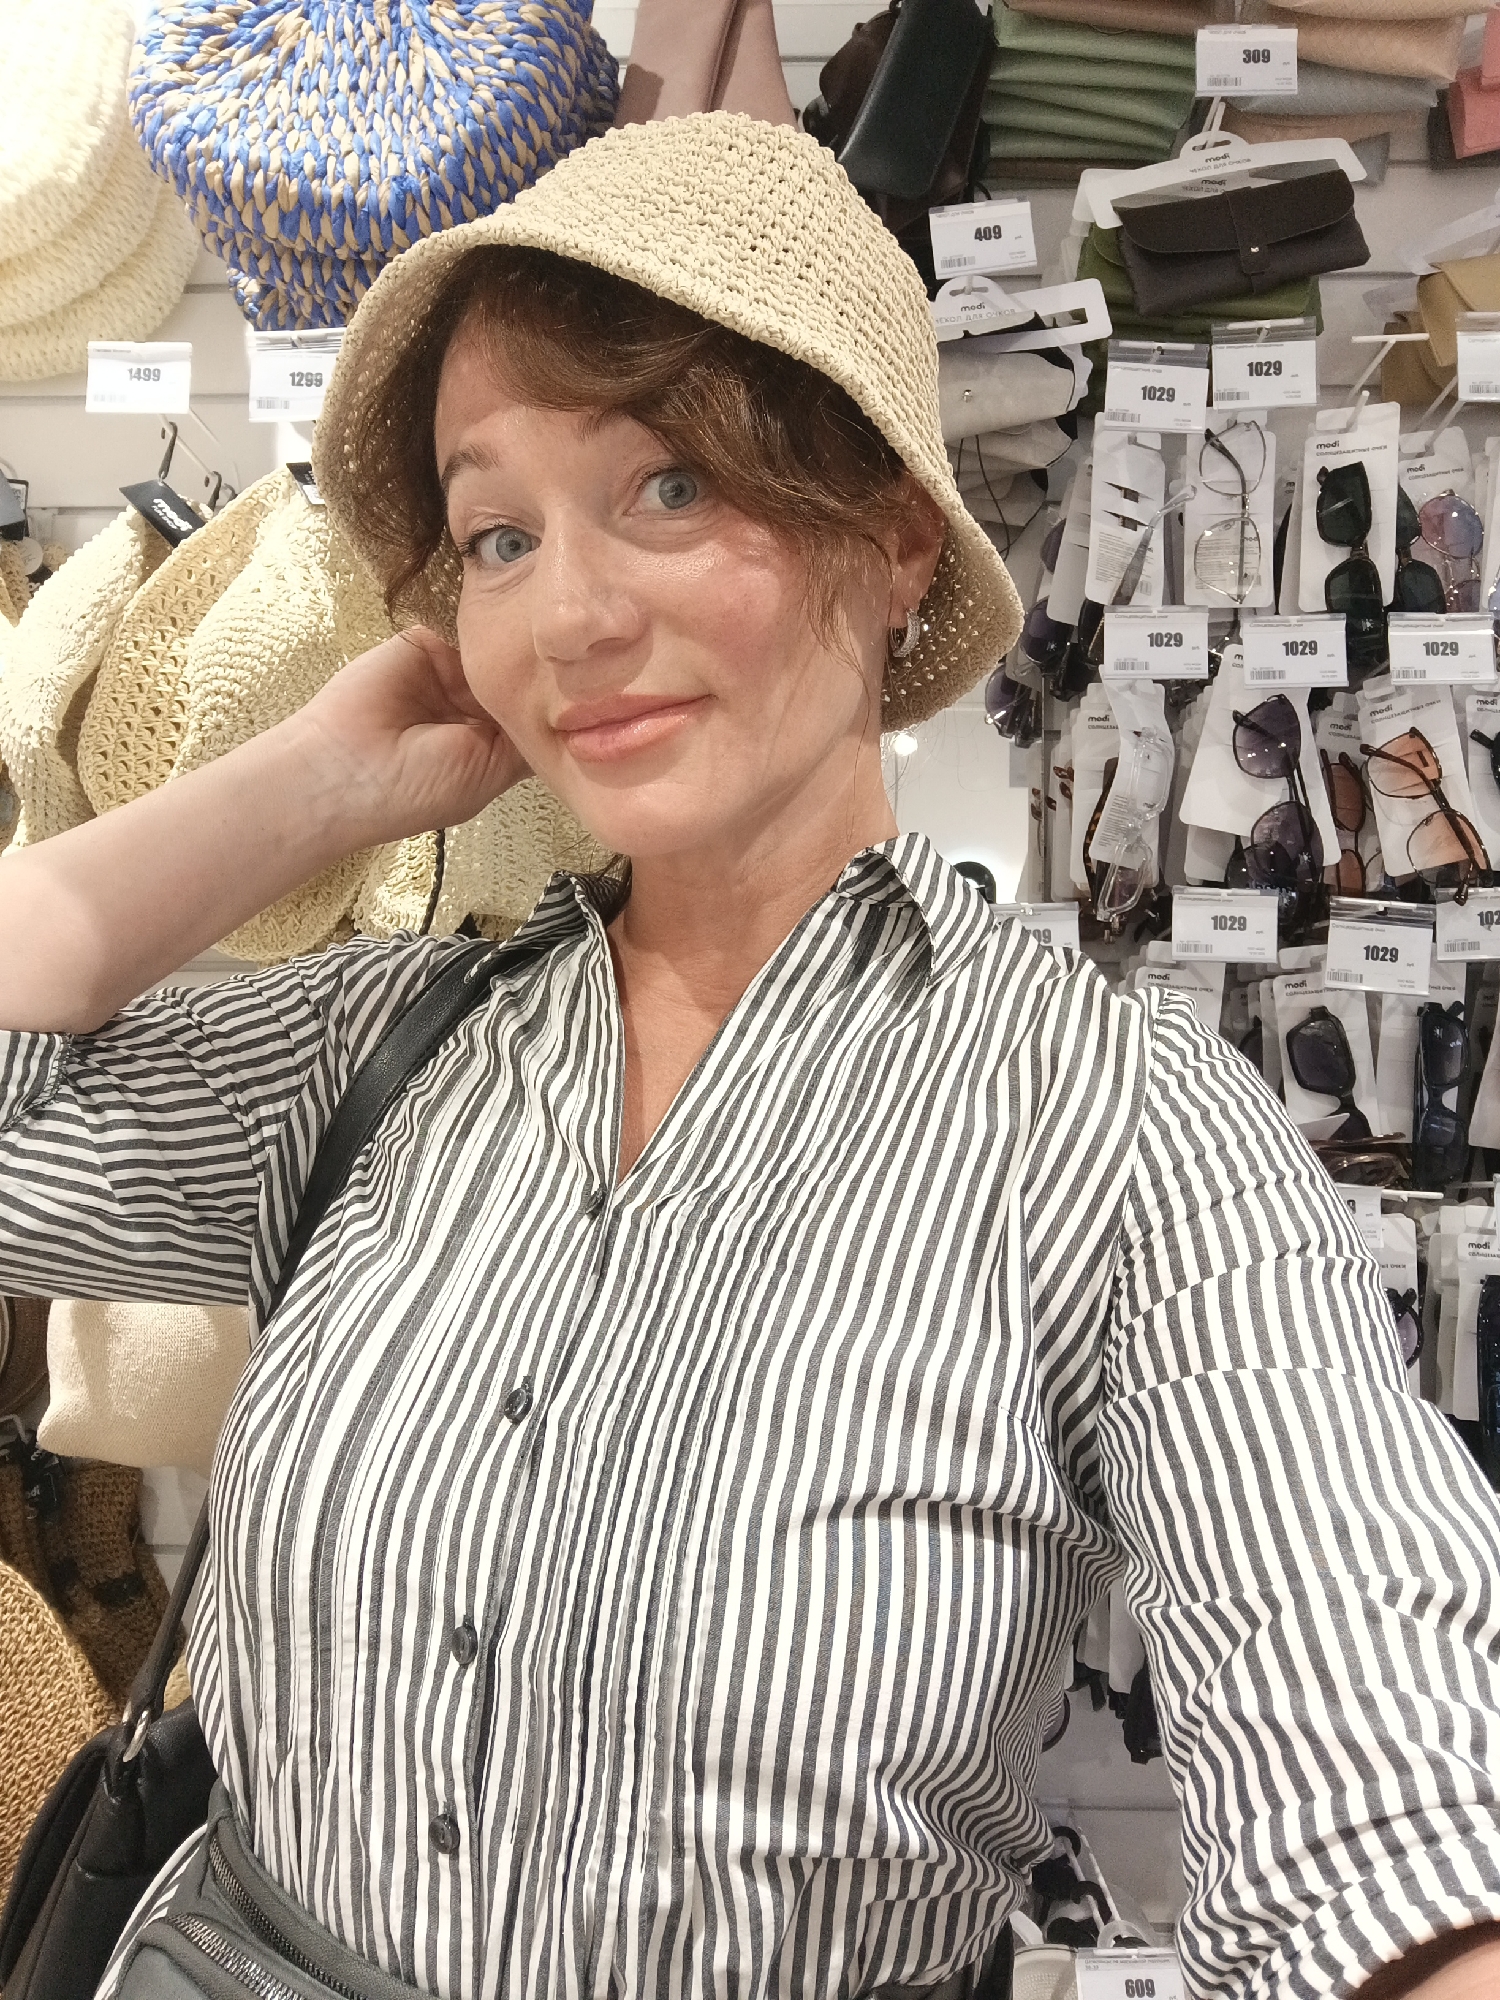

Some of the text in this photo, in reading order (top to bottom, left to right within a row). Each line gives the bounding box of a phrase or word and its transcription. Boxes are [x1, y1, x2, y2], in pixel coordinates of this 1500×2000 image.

[1242, 49, 1270, 64] 309
[1205, 153, 1230, 163] modi
[1201, 179, 1227, 187] modi
[974, 225, 1002, 241] 409
[960, 302, 986, 312] modi
[127, 368, 161, 381] 1499
[1247, 360, 1283, 376] 1029
[289, 371, 323, 387] 1299
[1141, 385, 1176, 402] 1029
[1316, 440, 1339, 450] modi
[1406, 464, 1425, 473] modi
[1147, 632, 1183, 647] 1029
[1282, 640, 1318, 656] 1029
[1423, 641, 1459, 656] 1029
[1476, 698, 1498, 706] modi
[1369, 703, 1393, 717] modi
[1087, 715, 1110, 723] modi
[1329, 723, 1352, 731] modi
[1211, 915, 1247, 931] 1029
[1363, 945, 1399, 963] 1029
[1148, 973, 1170, 981] modi
[1284, 980, 1308, 989] modi
[1468, 1242, 1491, 1250] modi
[1124, 1978, 1156, 1998] 609
